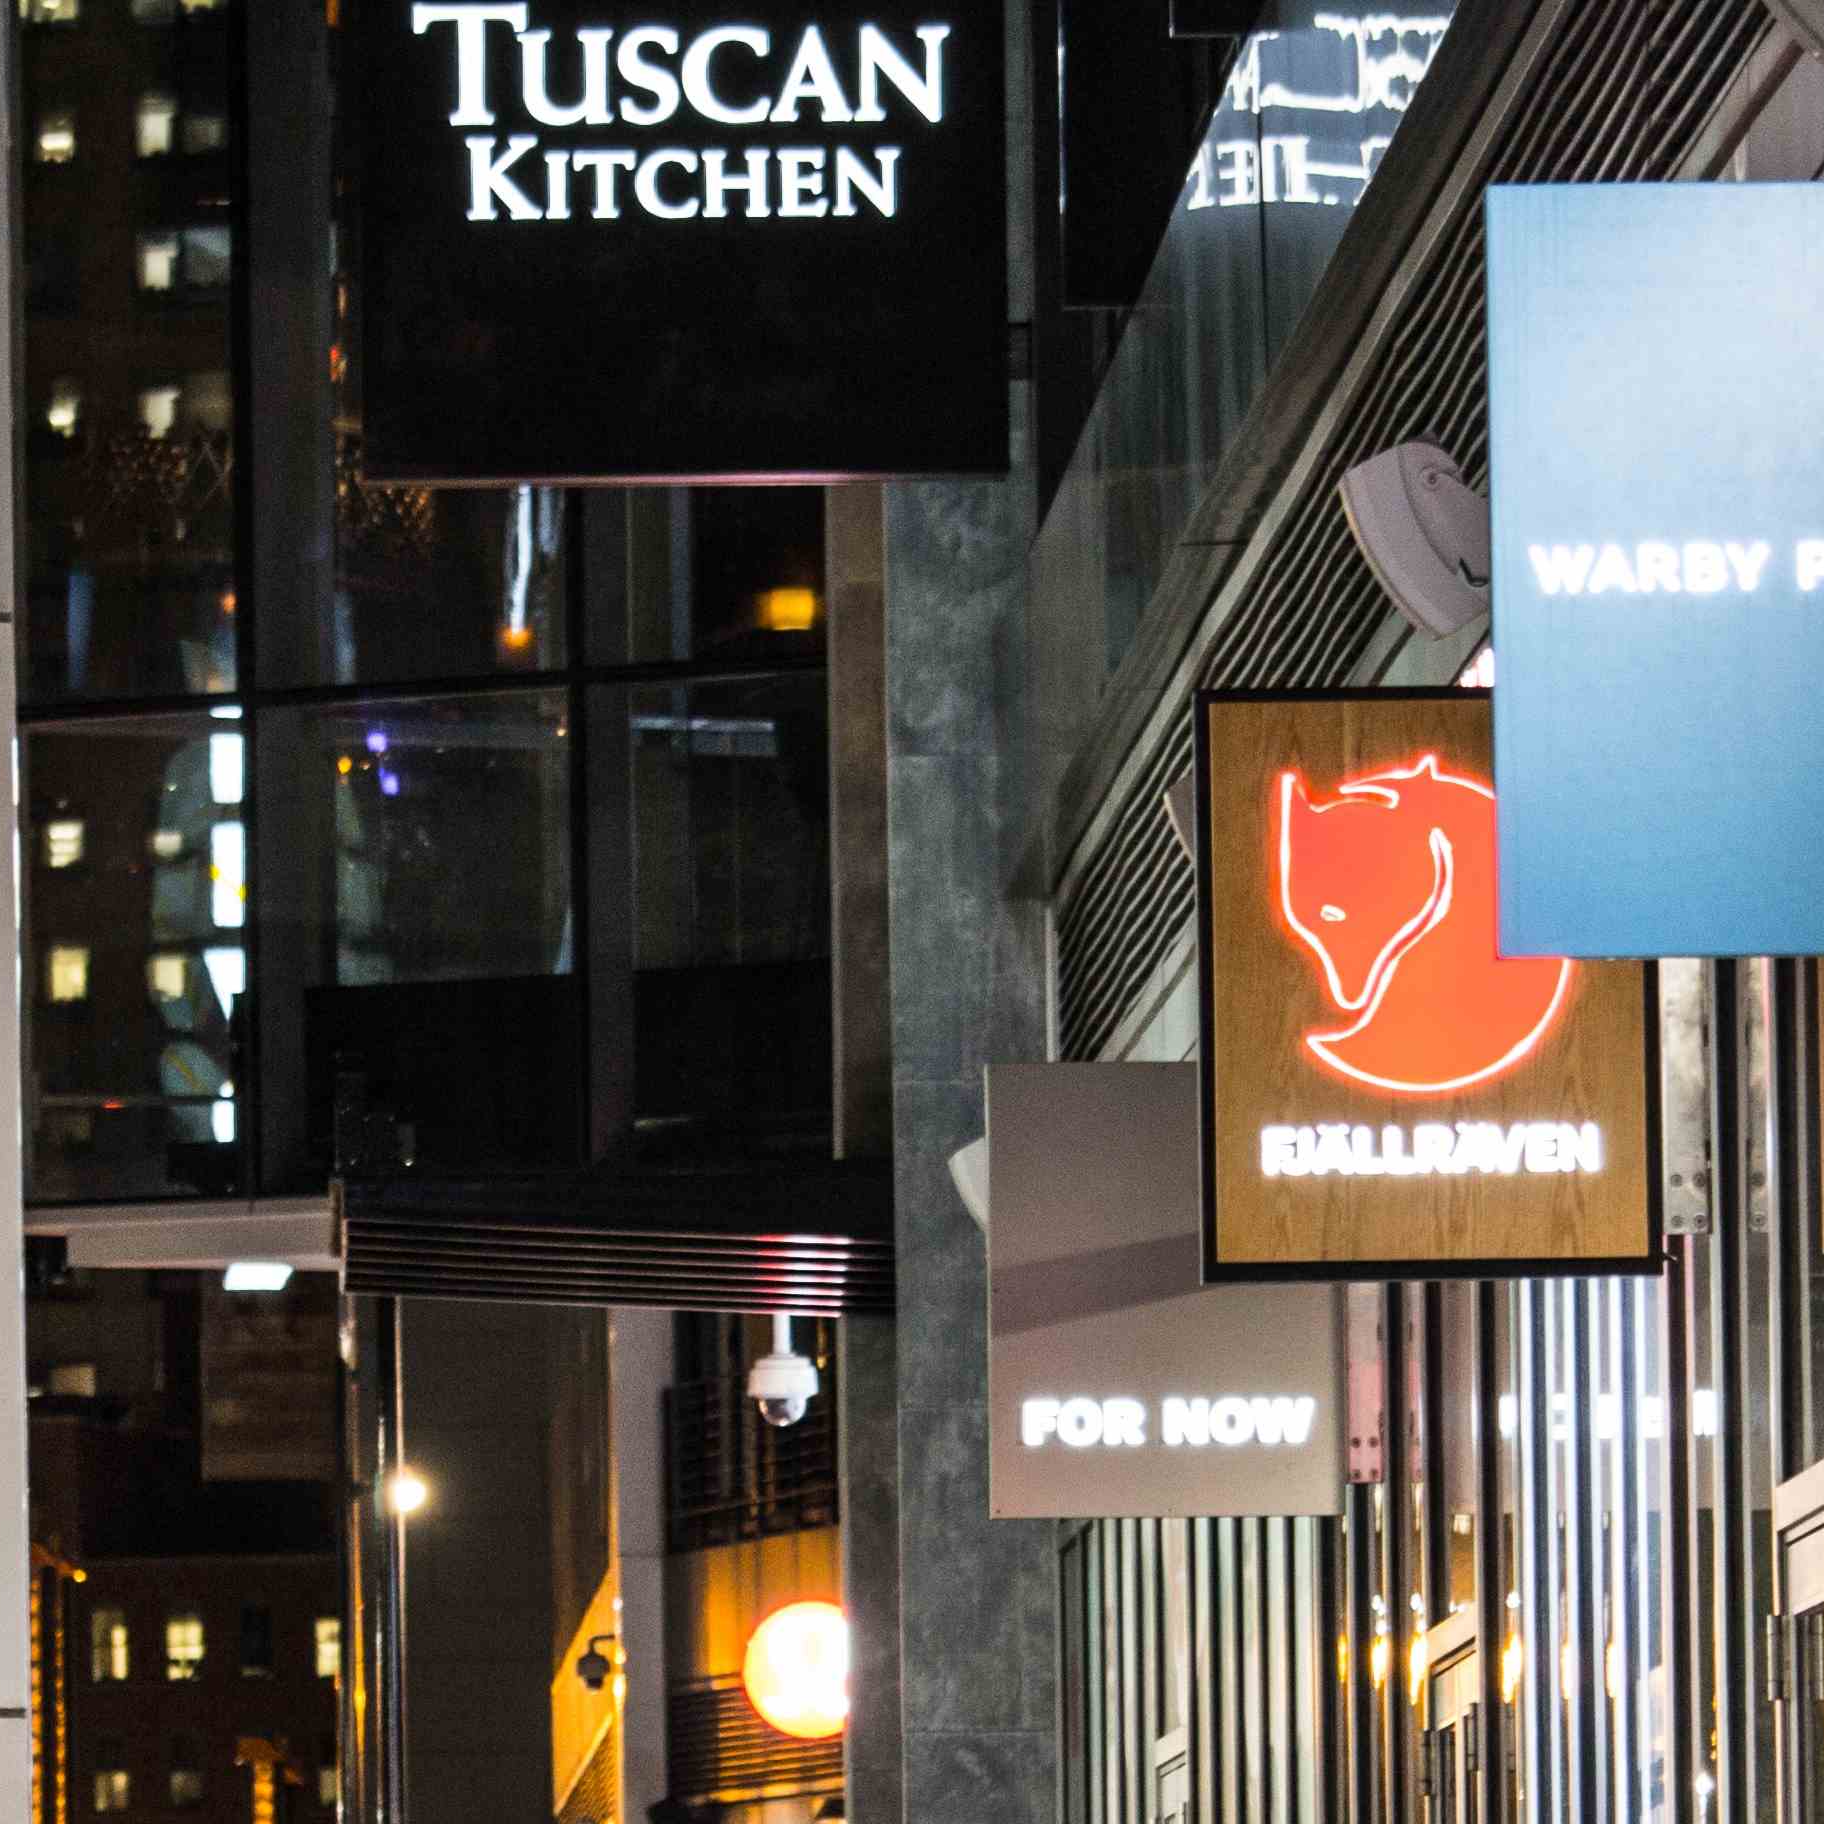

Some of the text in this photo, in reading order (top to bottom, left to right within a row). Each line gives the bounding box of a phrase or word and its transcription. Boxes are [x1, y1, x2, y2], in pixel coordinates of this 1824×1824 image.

[412, 2, 951, 127] TUSCAN
[465, 134, 901, 222] KITCHEN
[1527, 537, 1774, 597] WARBY
[1260, 1121, 1603, 1177] FJÄLLRÄVEN
[1022, 1396, 1316, 1448] FOR NOW
